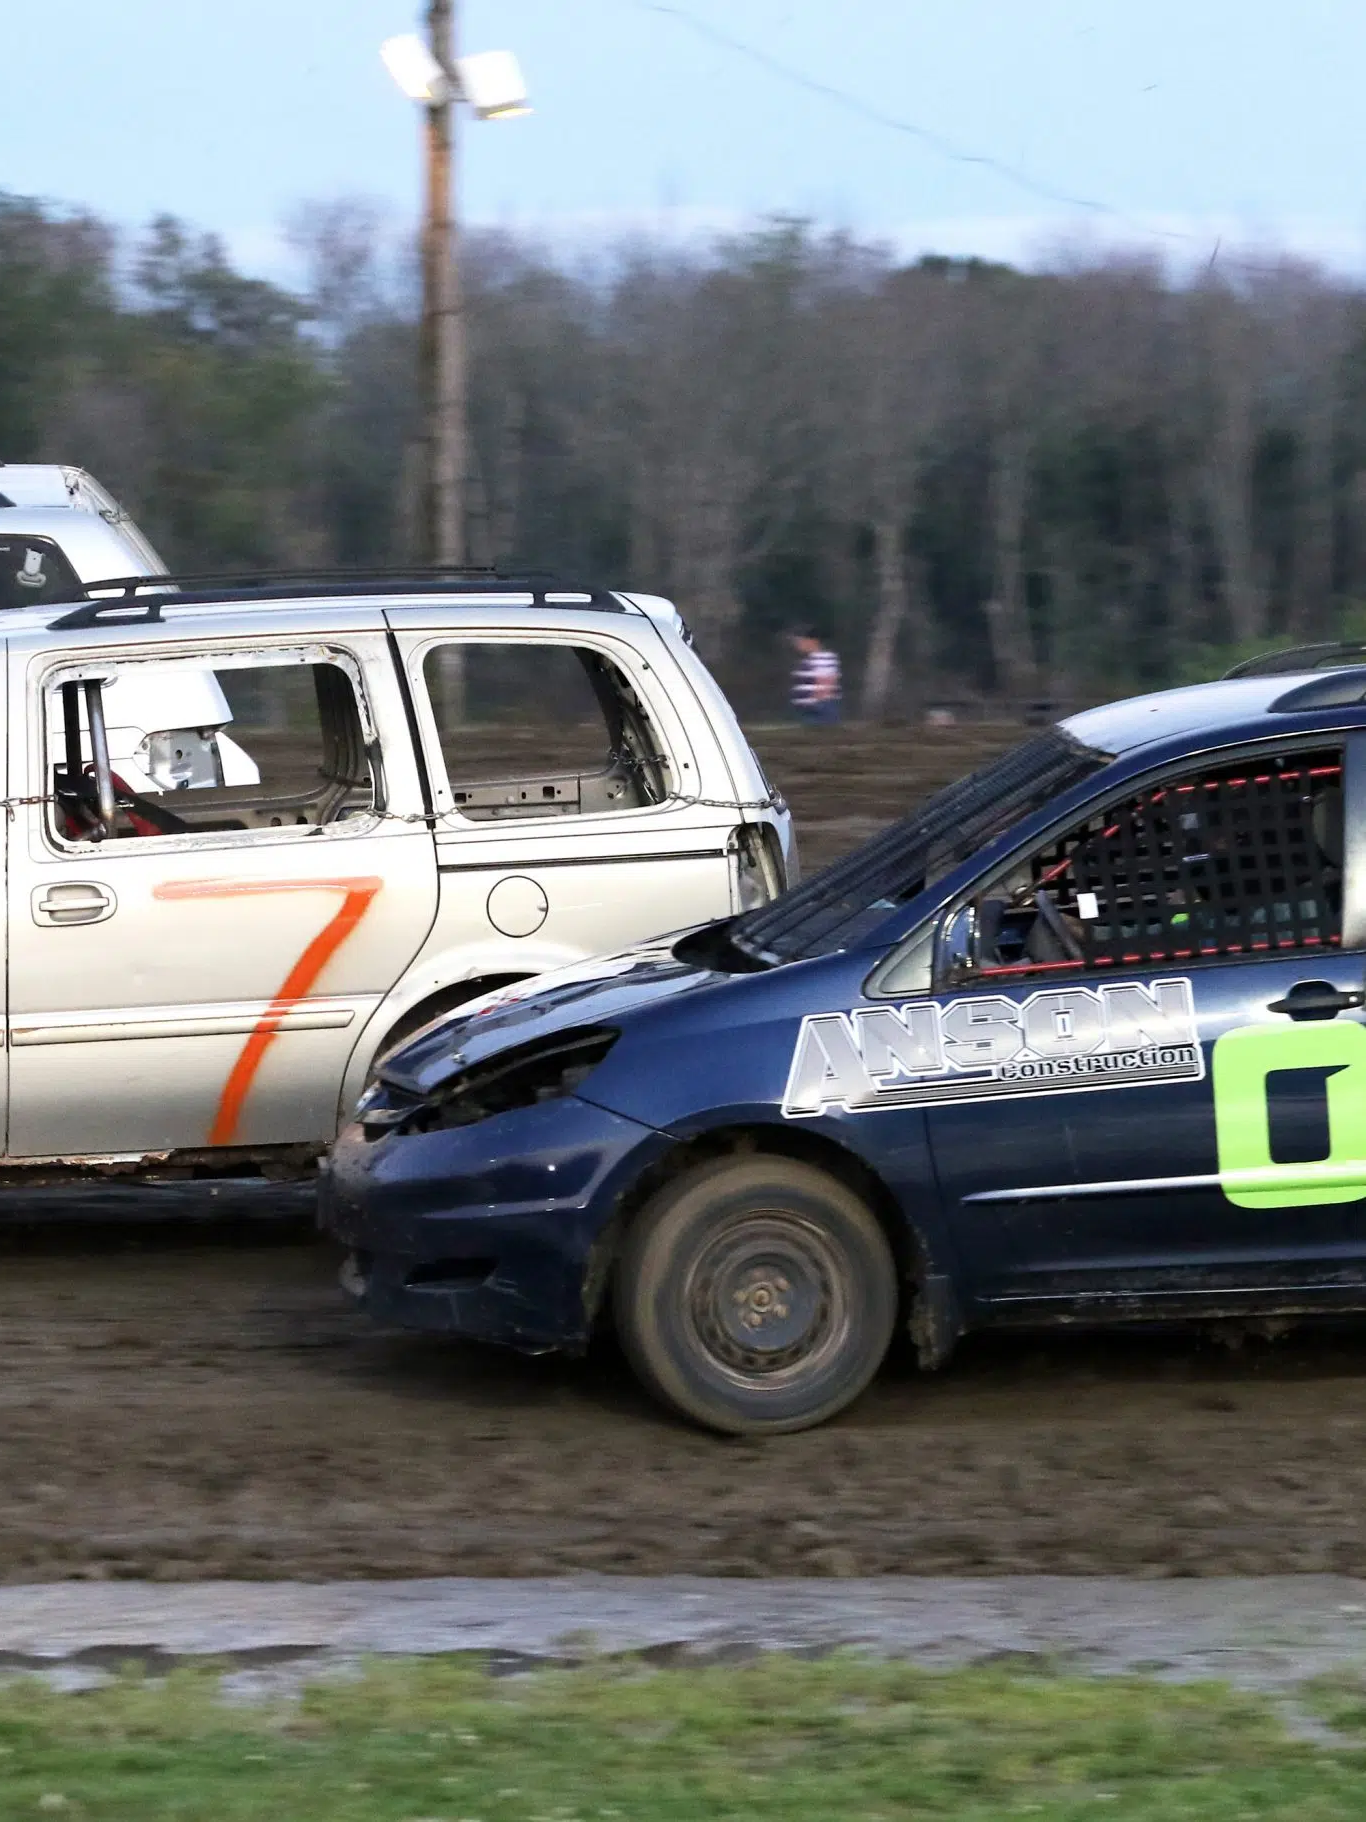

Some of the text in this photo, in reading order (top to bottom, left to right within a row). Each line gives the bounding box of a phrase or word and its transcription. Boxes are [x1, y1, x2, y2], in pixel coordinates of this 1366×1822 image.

[152, 875, 385, 1145] 7
[783, 978, 1198, 1116] ANSON
[999, 1044, 1195, 1081] Construction
